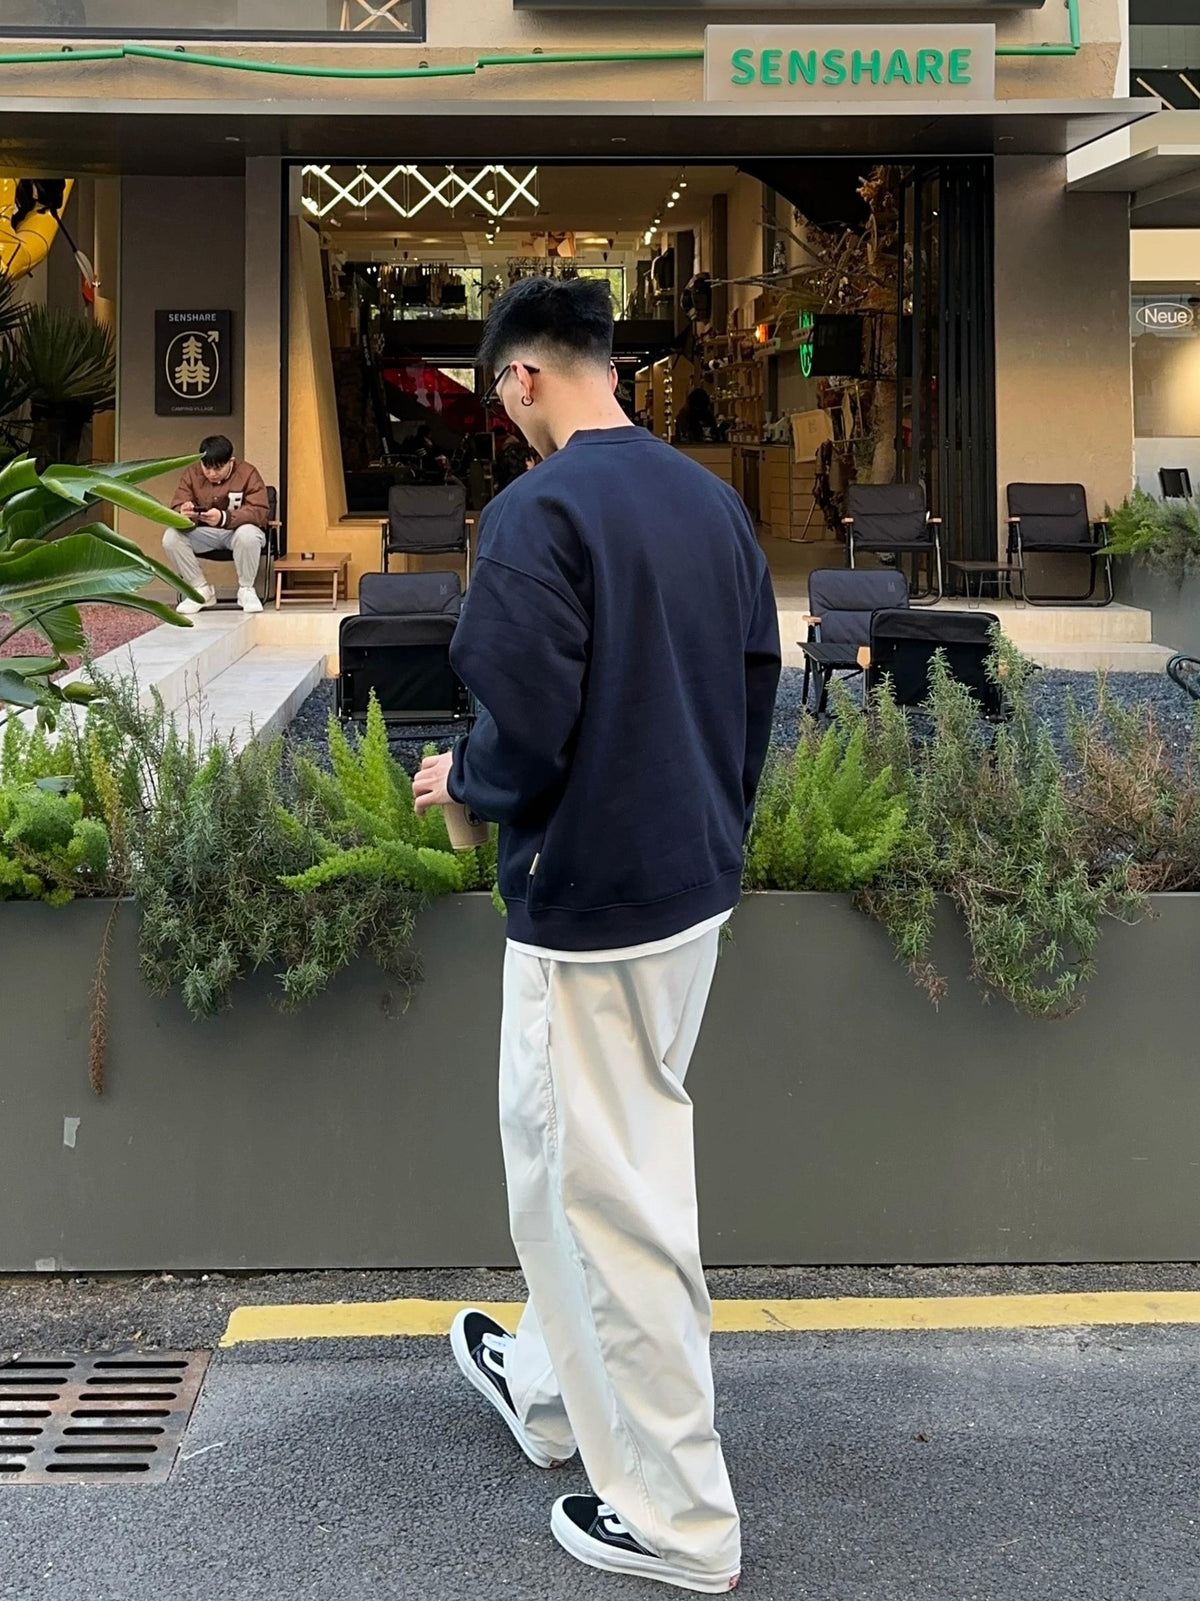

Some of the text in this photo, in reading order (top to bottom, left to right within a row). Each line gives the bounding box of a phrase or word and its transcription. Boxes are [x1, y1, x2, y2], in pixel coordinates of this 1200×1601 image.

[730, 48, 972, 85] SENSHARE
[168, 313, 217, 322] SENSHARE
[1144, 308, 1188, 323] Neue
